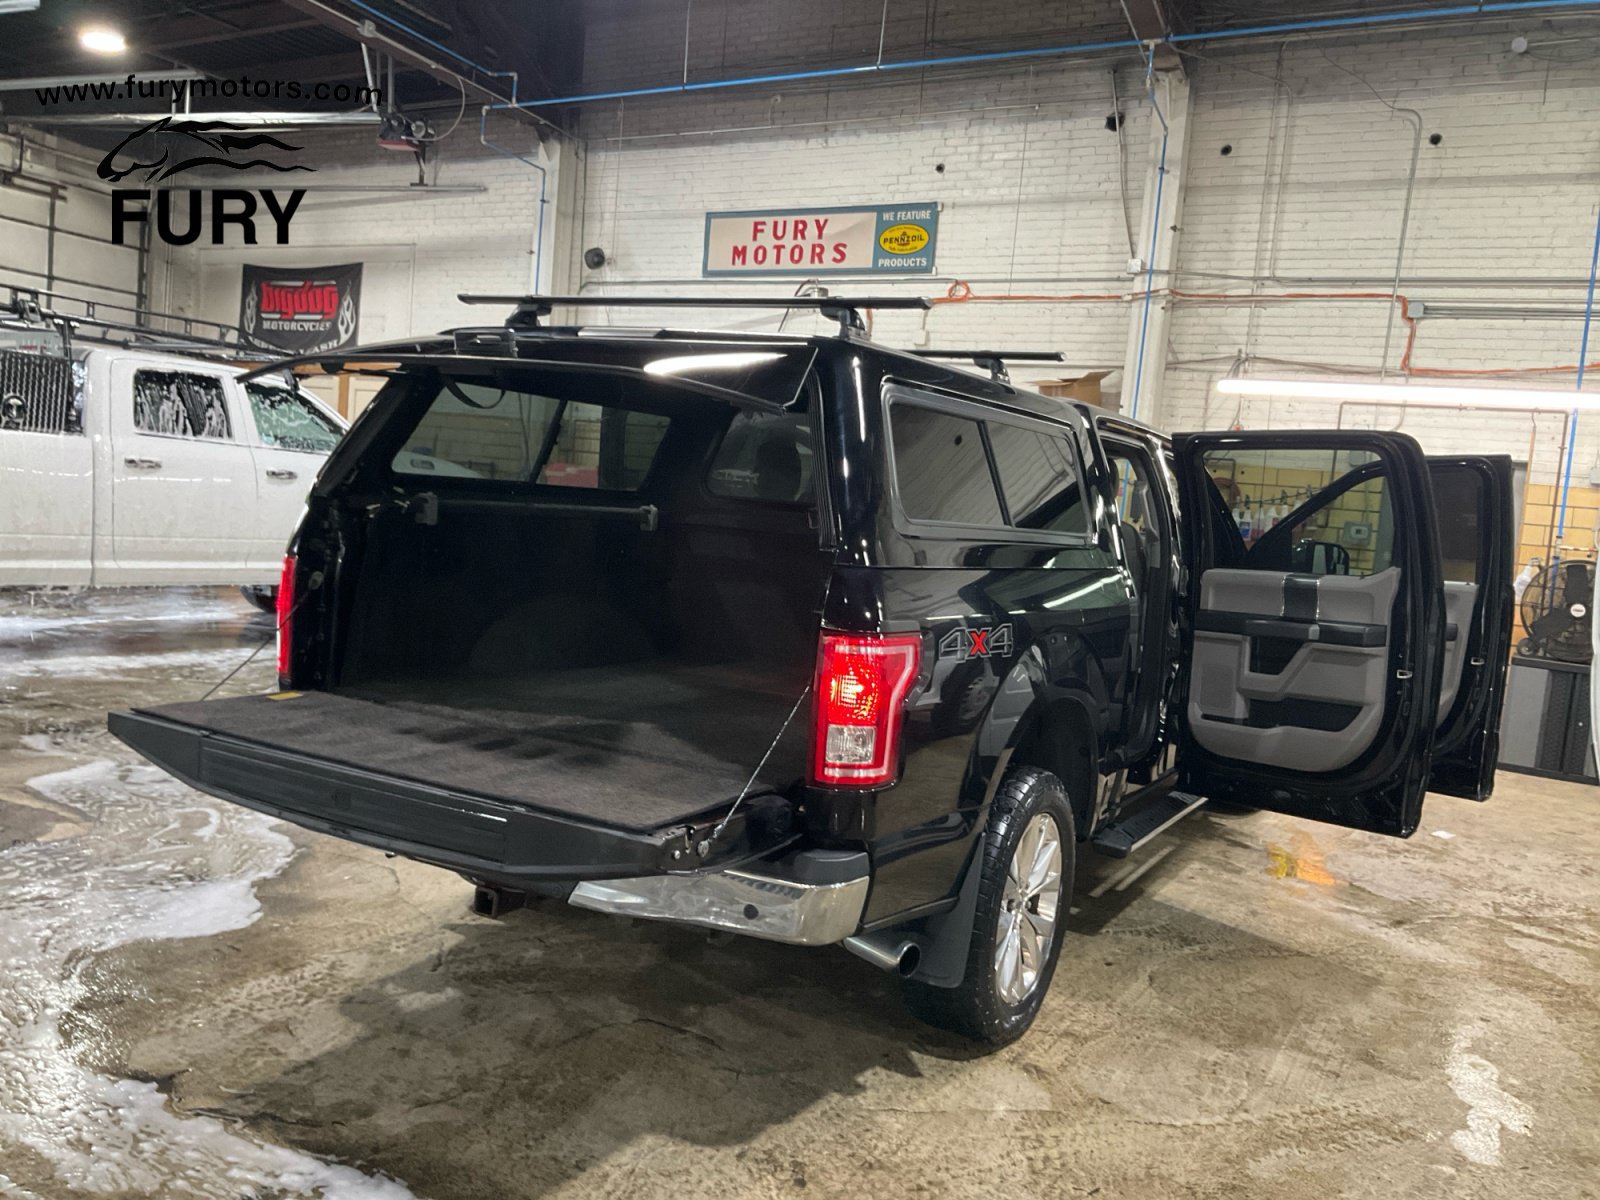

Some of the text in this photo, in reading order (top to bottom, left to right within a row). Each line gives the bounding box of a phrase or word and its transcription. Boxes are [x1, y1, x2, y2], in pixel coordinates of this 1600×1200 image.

[883, 210, 931, 221] WE FEATURE
[752, 218, 829, 242] FURY
[883, 234, 925, 245] PENNZOIL
[731, 243, 848, 266] MOTORS
[878, 257, 928, 268] PRODUCTS
[262, 320, 332, 331] MOTORCYCLES
